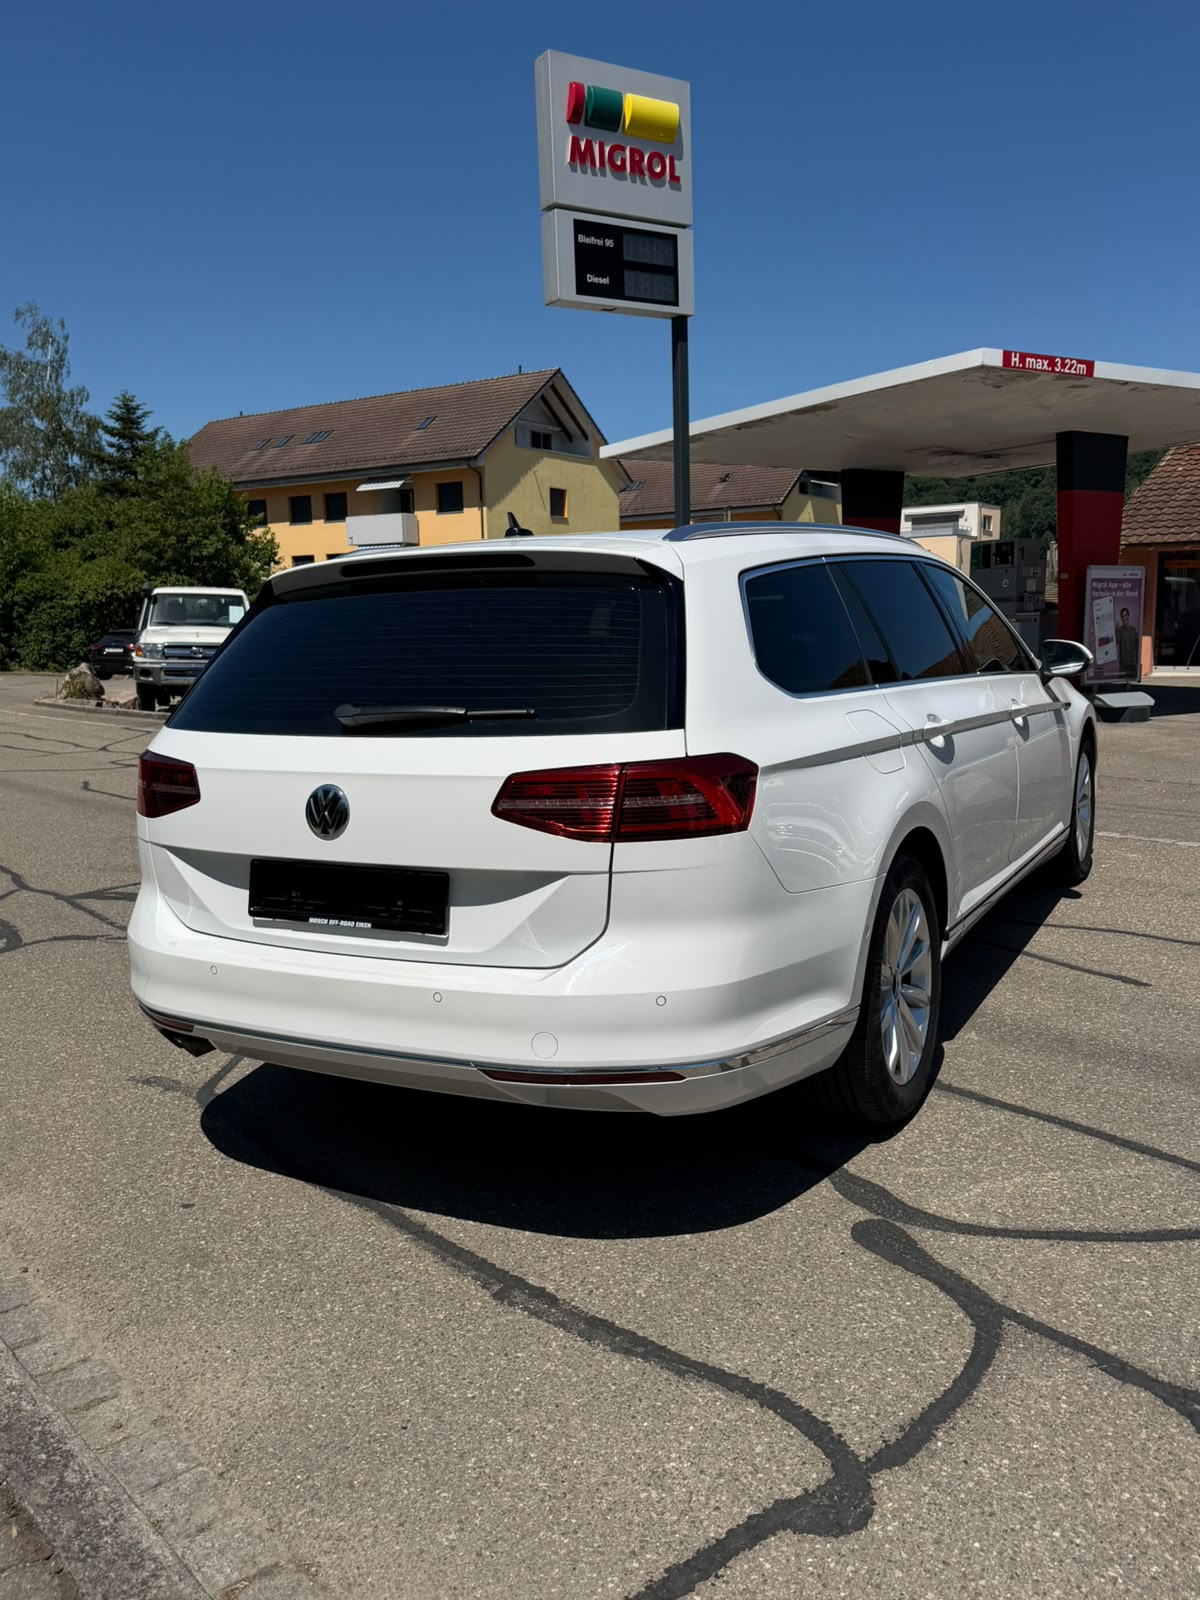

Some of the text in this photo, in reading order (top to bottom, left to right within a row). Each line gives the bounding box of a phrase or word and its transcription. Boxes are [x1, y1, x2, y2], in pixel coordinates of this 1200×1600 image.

[568, 135, 681, 185] MIGROL
[577, 234, 615, 248] Bleifrei 95
[586, 273, 610, 285] Diesel
[1011, 352, 1087, 375] H. max. 3.22m
[329, 919, 355, 927] OFF-ROAD
[355, 921, 372, 929] EIKEN
